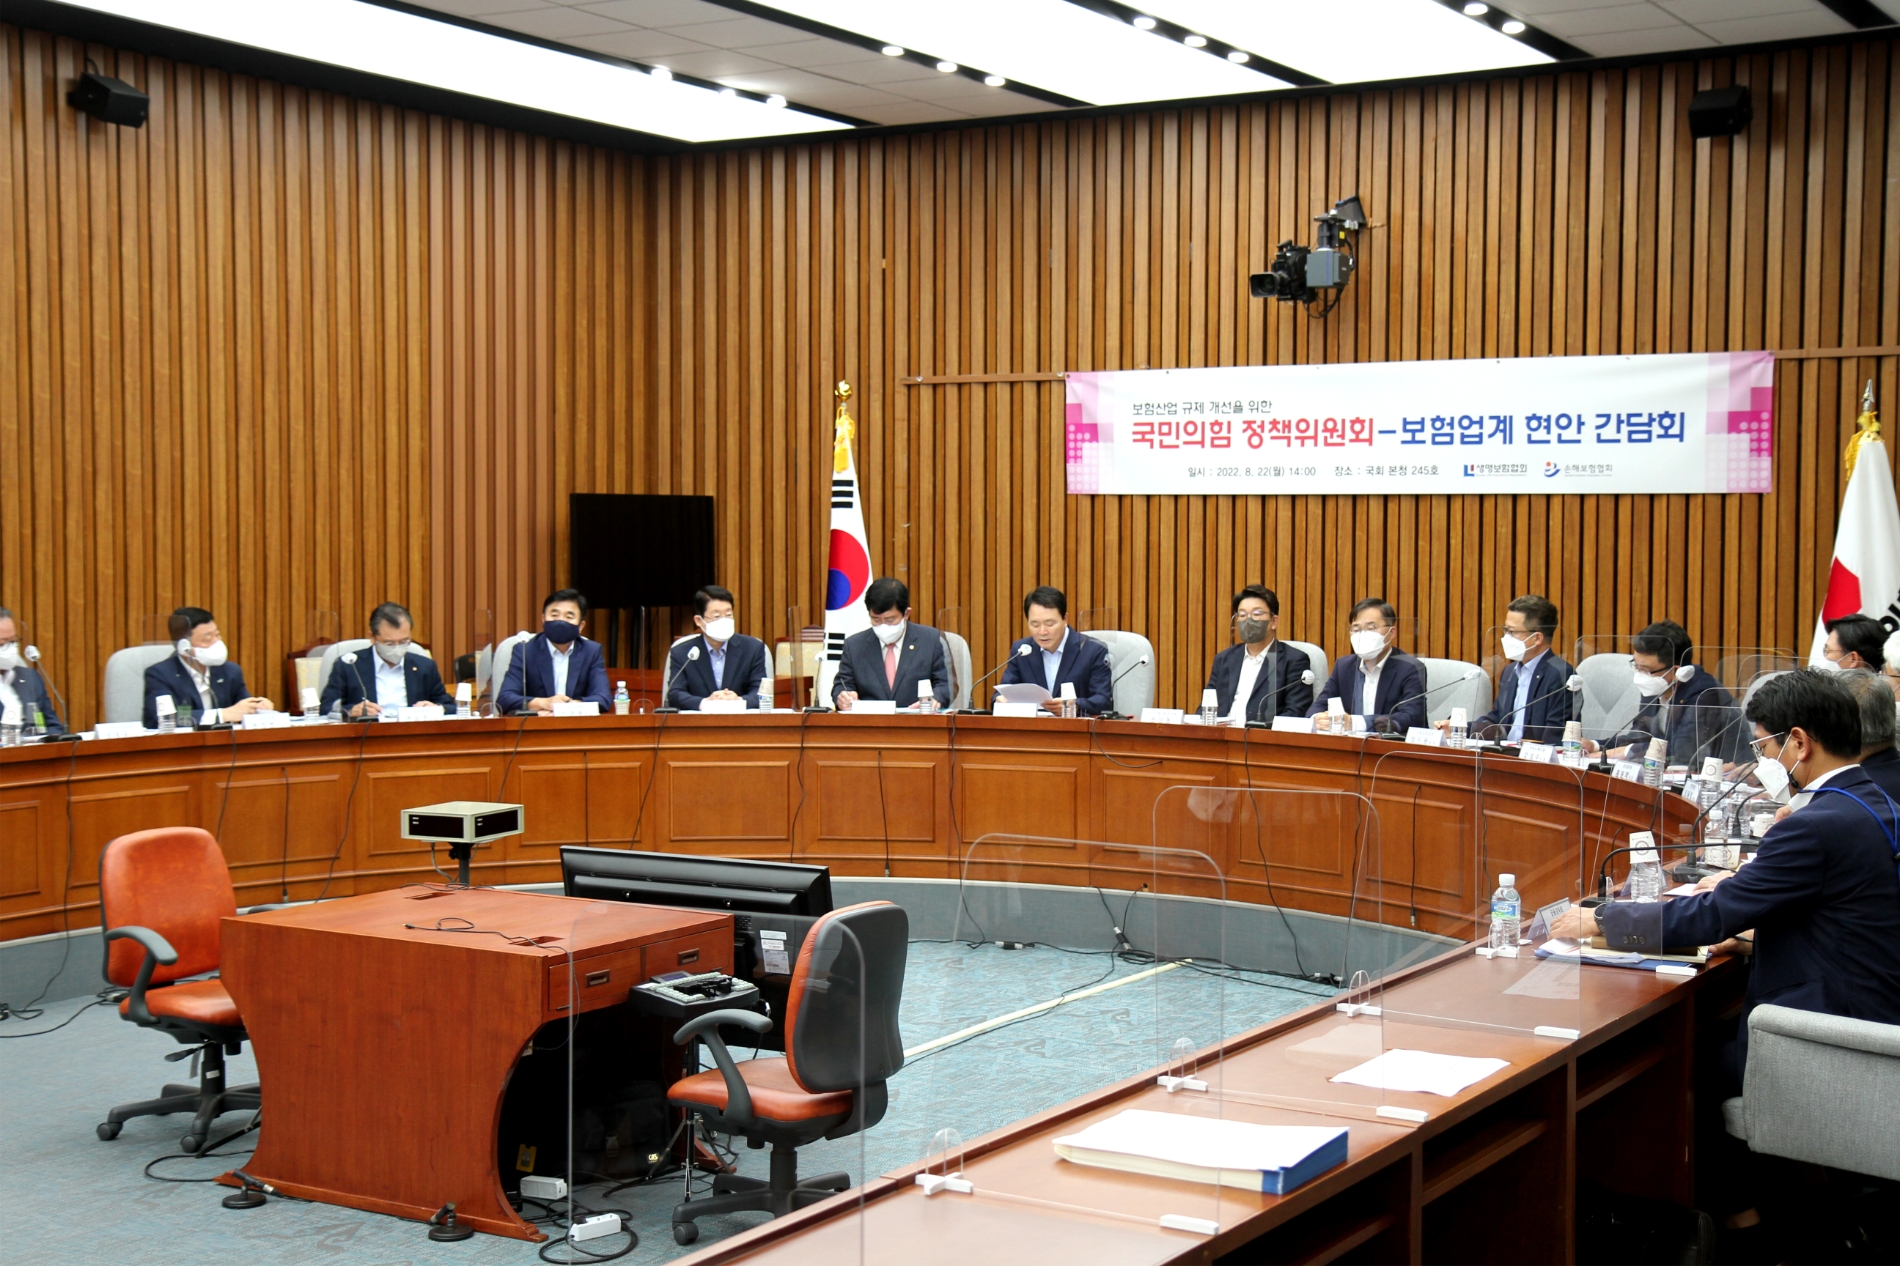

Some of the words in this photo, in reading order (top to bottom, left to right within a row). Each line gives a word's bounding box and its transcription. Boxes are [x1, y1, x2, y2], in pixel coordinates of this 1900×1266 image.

[1132, 401, 1178, 416] 보험산업
[1181, 401, 1205, 415] 규제
[1208, 400, 1244, 415] 개선을
[1248, 400, 1273, 414] 위한
[1131, 419, 1232, 450] 국민의힘
[1524, 412, 1586, 445] 현안
[1594, 410, 1686, 444] 간담회
[1187, 466, 1206, 477] 일시
[1216, 467, 1242, 477] 2022.
[1245, 466, 1254, 477] 8.
[1258, 465, 1285, 478] 22(월)
[1289, 466, 1317, 477] 14:00
[1334, 465, 1353, 477] 장소
[1365, 465, 1385, 477] 국회
[1387, 464, 1408, 477] 본청
[1411, 464, 1440, 476] 245호
[1476, 463, 1528, 473] 생명보험협회
[1564, 463, 1613, 474] 손해보험협회
